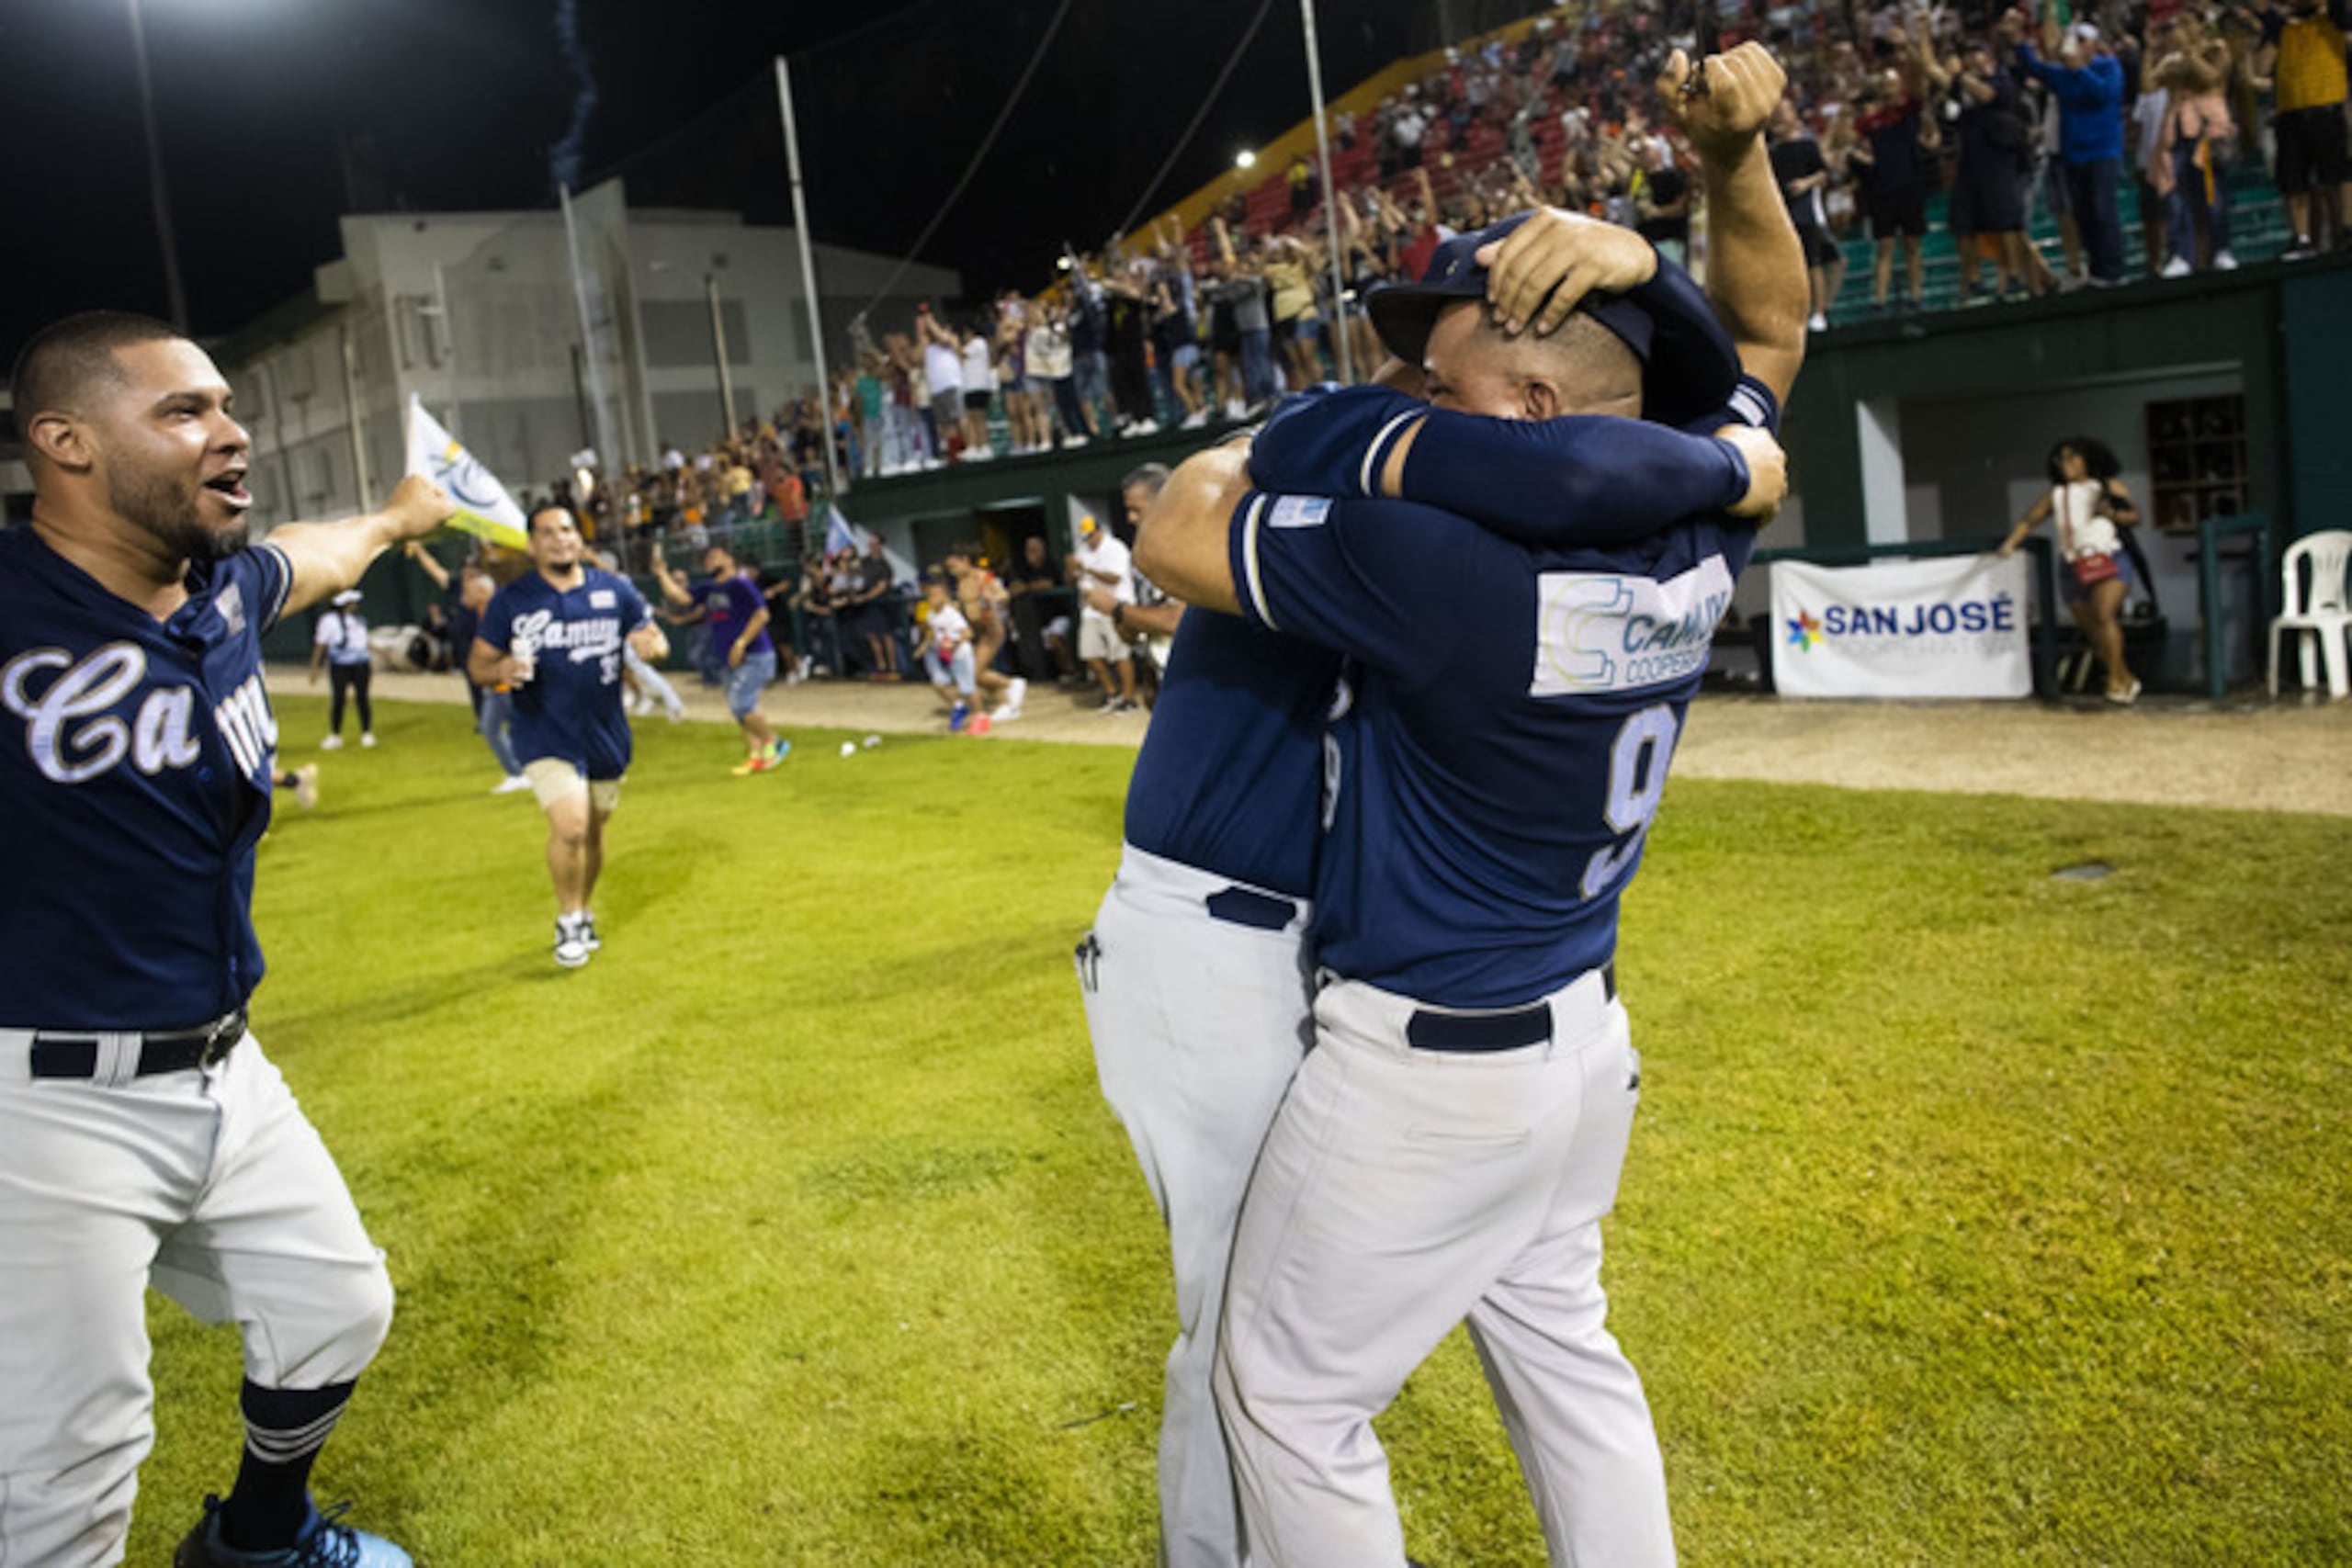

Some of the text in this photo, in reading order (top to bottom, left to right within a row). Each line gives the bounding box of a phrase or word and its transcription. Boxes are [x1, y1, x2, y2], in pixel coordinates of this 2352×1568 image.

[1824, 592, 2015, 637] SAN JOSÉ
[1577, 703, 1678, 903] 9
